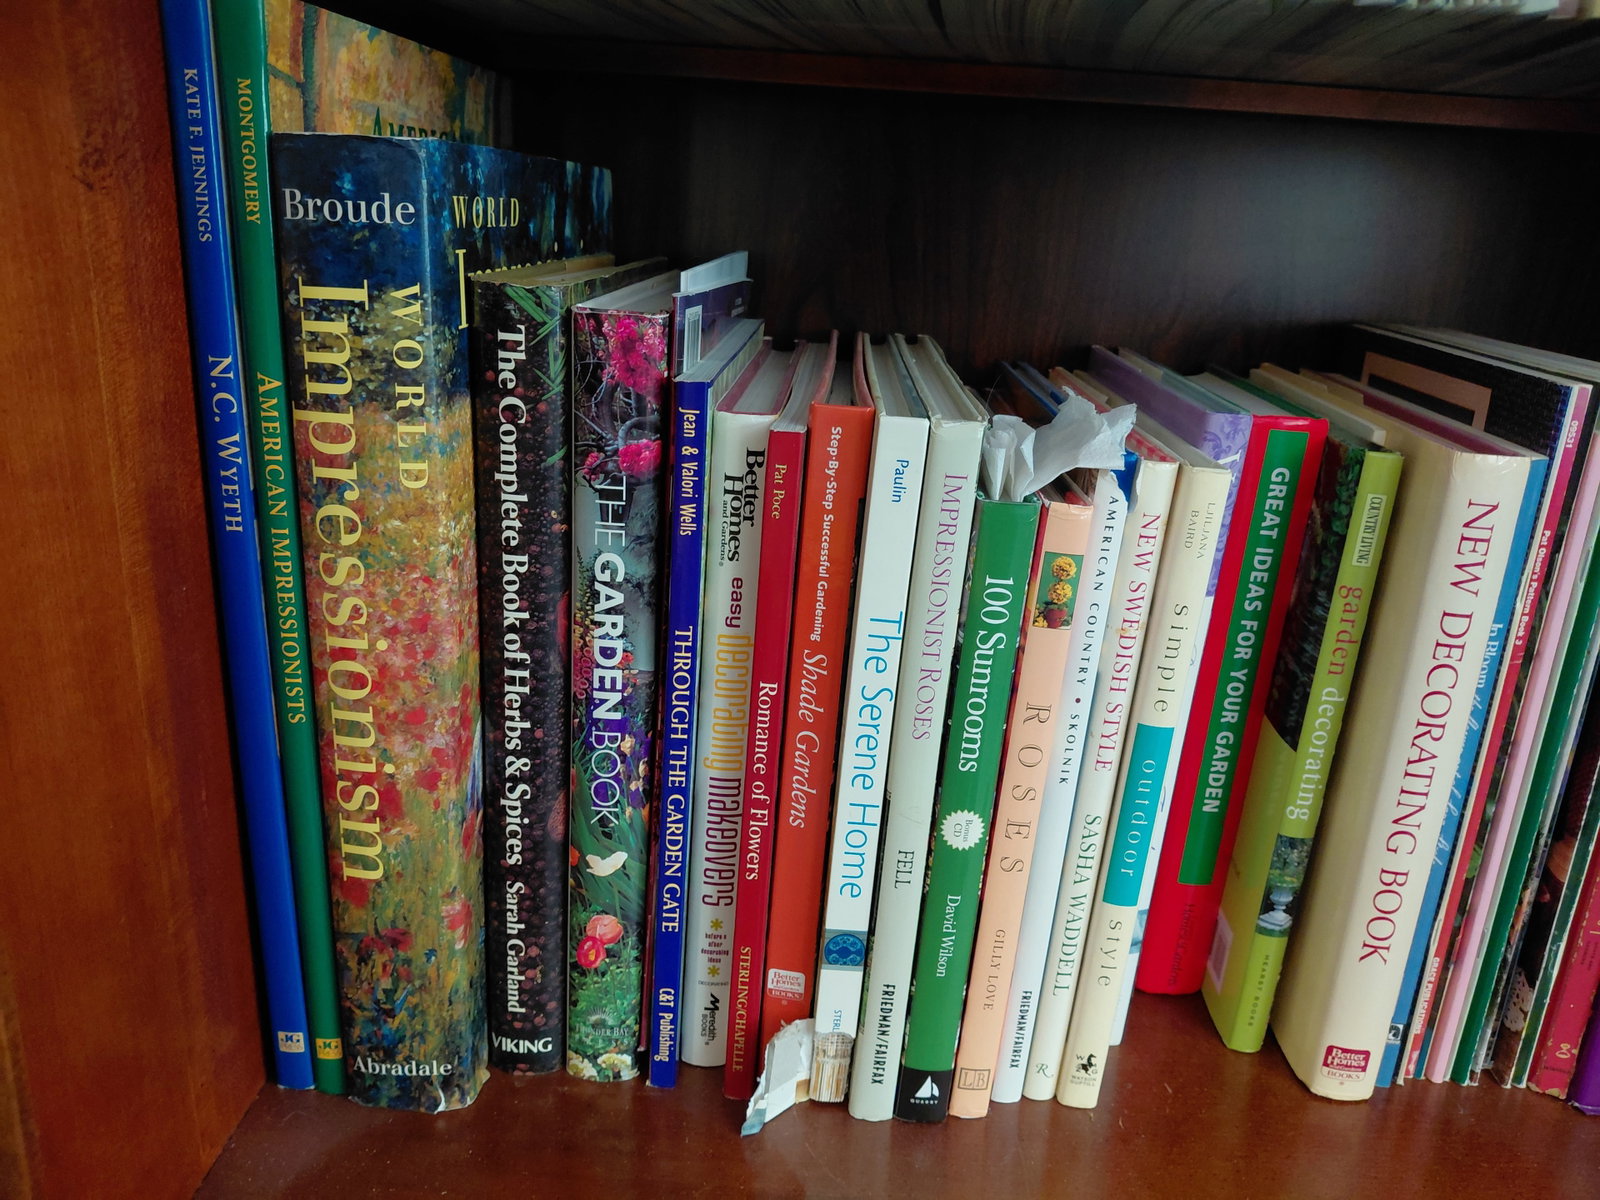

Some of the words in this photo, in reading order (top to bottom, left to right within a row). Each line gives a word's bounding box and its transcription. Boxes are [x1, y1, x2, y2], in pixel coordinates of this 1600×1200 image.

[184, 68, 202, 119] KATE
[188, 126, 203, 140] F.
[236, 78, 261, 225] MONTGOMERY
[190, 146, 213, 242] JENNINGS
[282, 188, 415, 225] Broude
[452, 195, 520, 229] WORLD
[208, 354, 238, 423] N.C.
[389, 281, 429, 490] WORLD
[497, 325, 528, 389] The
[256, 371, 288, 518] AMERICAN
[679, 407, 700, 438] Jean
[681, 445, 699, 456] &
[216, 432, 244, 533] WYETH
[495, 396, 530, 547] Complete
[679, 460, 699, 498] Valori
[745, 447, 766, 528] Better
[773, 464, 788, 484] Pat
[891, 459, 910, 503] Paulin
[1260, 467, 1290, 540] GREAT
[593, 475, 627, 547] THE
[679, 503, 698, 536] Wells
[723, 472, 745, 562] Homes
[771, 489, 786, 519] Poce
[1184, 510, 1200, 549] BAIRD
[1362, 496, 1383, 536] COUNTRY
[720, 521, 729, 561] Gardens
[818, 513, 835, 577] Successful
[921, 472, 969, 662] IMPRESSIONIST
[1093, 495, 1119, 592] AMERICAN
[1132, 512, 1161, 575] NEW
[1356, 537, 1374, 564] LIVING
[1449, 498, 1500, 598] NEW
[1541, 529, 1552, 546] Pat
[292, 275, 395, 882] Impressionism
[502, 553, 531, 627] Book
[725, 577, 744, 628] easy
[979, 573, 1015, 626] 100
[1243, 548, 1275, 612] IDEAS
[1523, 581, 1538, 614] Pattern
[270, 527, 306, 724] IMPRESSIONISTS
[591, 552, 626, 720] GARDEN
[810, 580, 828, 642] Gardening
[864, 610, 904, 674] The
[1108, 580, 1148, 695] SWEDISH
[1232, 620, 1259, 659] FOR
[1328, 584, 1363, 676] garden
[1488, 623, 1503, 637] In
[1516, 615, 1529, 637] Book
[504, 633, 531, 664] of
[1075, 603, 1100, 686] COUNTRY
[504, 668, 532, 750] Herbs
[669, 625, 693, 740] THROUGH
[703, 634, 754, 772] decorating
[798, 649, 828, 723] Shade
[911, 667, 944, 741] ROSES
[957, 629, 1008, 773] Sunrooms
[1219, 668, 1249, 724] YOUR
[752, 681, 779, 774] Romance
[851, 685, 894, 791] Serene
[1058, 713, 1081, 785] SKOLNIK
[1094, 703, 1124, 772] STYLE
[1286, 687, 1344, 821] decorating
[1385, 610, 1474, 856] DECORATING
[505, 756, 532, 778] &
[590, 731, 622, 825] BOOK
[667, 745, 688, 787] THE
[751, 781, 770, 805] of
[789, 730, 820, 829] Gardens
[998, 702, 1052, 874] ROSES
[1201, 730, 1235, 813] GARDEN
[500, 782, 532, 866] Spices
[664, 794, 686, 877] GARDEN
[701, 776, 743, 907] makeovers
[745, 807, 769, 880] Flowers
[953, 822, 964, 838] CD
[1073, 814, 1103, 886] SASHA
[1120, 759, 1156, 877] outdoor
[839, 803, 880, 899] Home
[894, 848, 915, 889] FELL
[505, 881, 527, 935] Sarah
[661, 883, 682, 933] GATE
[946, 894, 962, 931] David
[1359, 867, 1410, 965] BOOK
[505, 939, 527, 1013] Garland
[774, 971, 800, 981] Better
[935, 932, 954, 978] Wilson
[989, 929, 1006, 971] GILLY
[1053, 893, 1088, 997] WADDELL
[1258, 954, 1270, 991] HEARST
[658, 987, 676, 1008] C&T
[732, 946, 752, 1072] STERLING/CHAPELLE
[771, 978, 801, 987] Homes
[982, 974, 999, 1011] LOVE
[1248, 996, 1260, 1027] BOOKS
[490, 1031, 553, 1055] VIKING
[654, 1012, 675, 1062] Publishing
[700, 1014, 708, 1037] BOOKS
[704, 993, 720, 1041] Meredith
[870, 983, 896, 1085] FRIEDMAN/FAIRFAX
[1009, 990, 1033, 1068] FRIEDMAN/FAIRFAX
[353, 1055, 452, 1077] Abradale
[1326, 1055, 1366, 1067] Homes
[1327, 1070, 1361, 1080] BOOKS
[1331, 1047, 1367, 1061] Better
